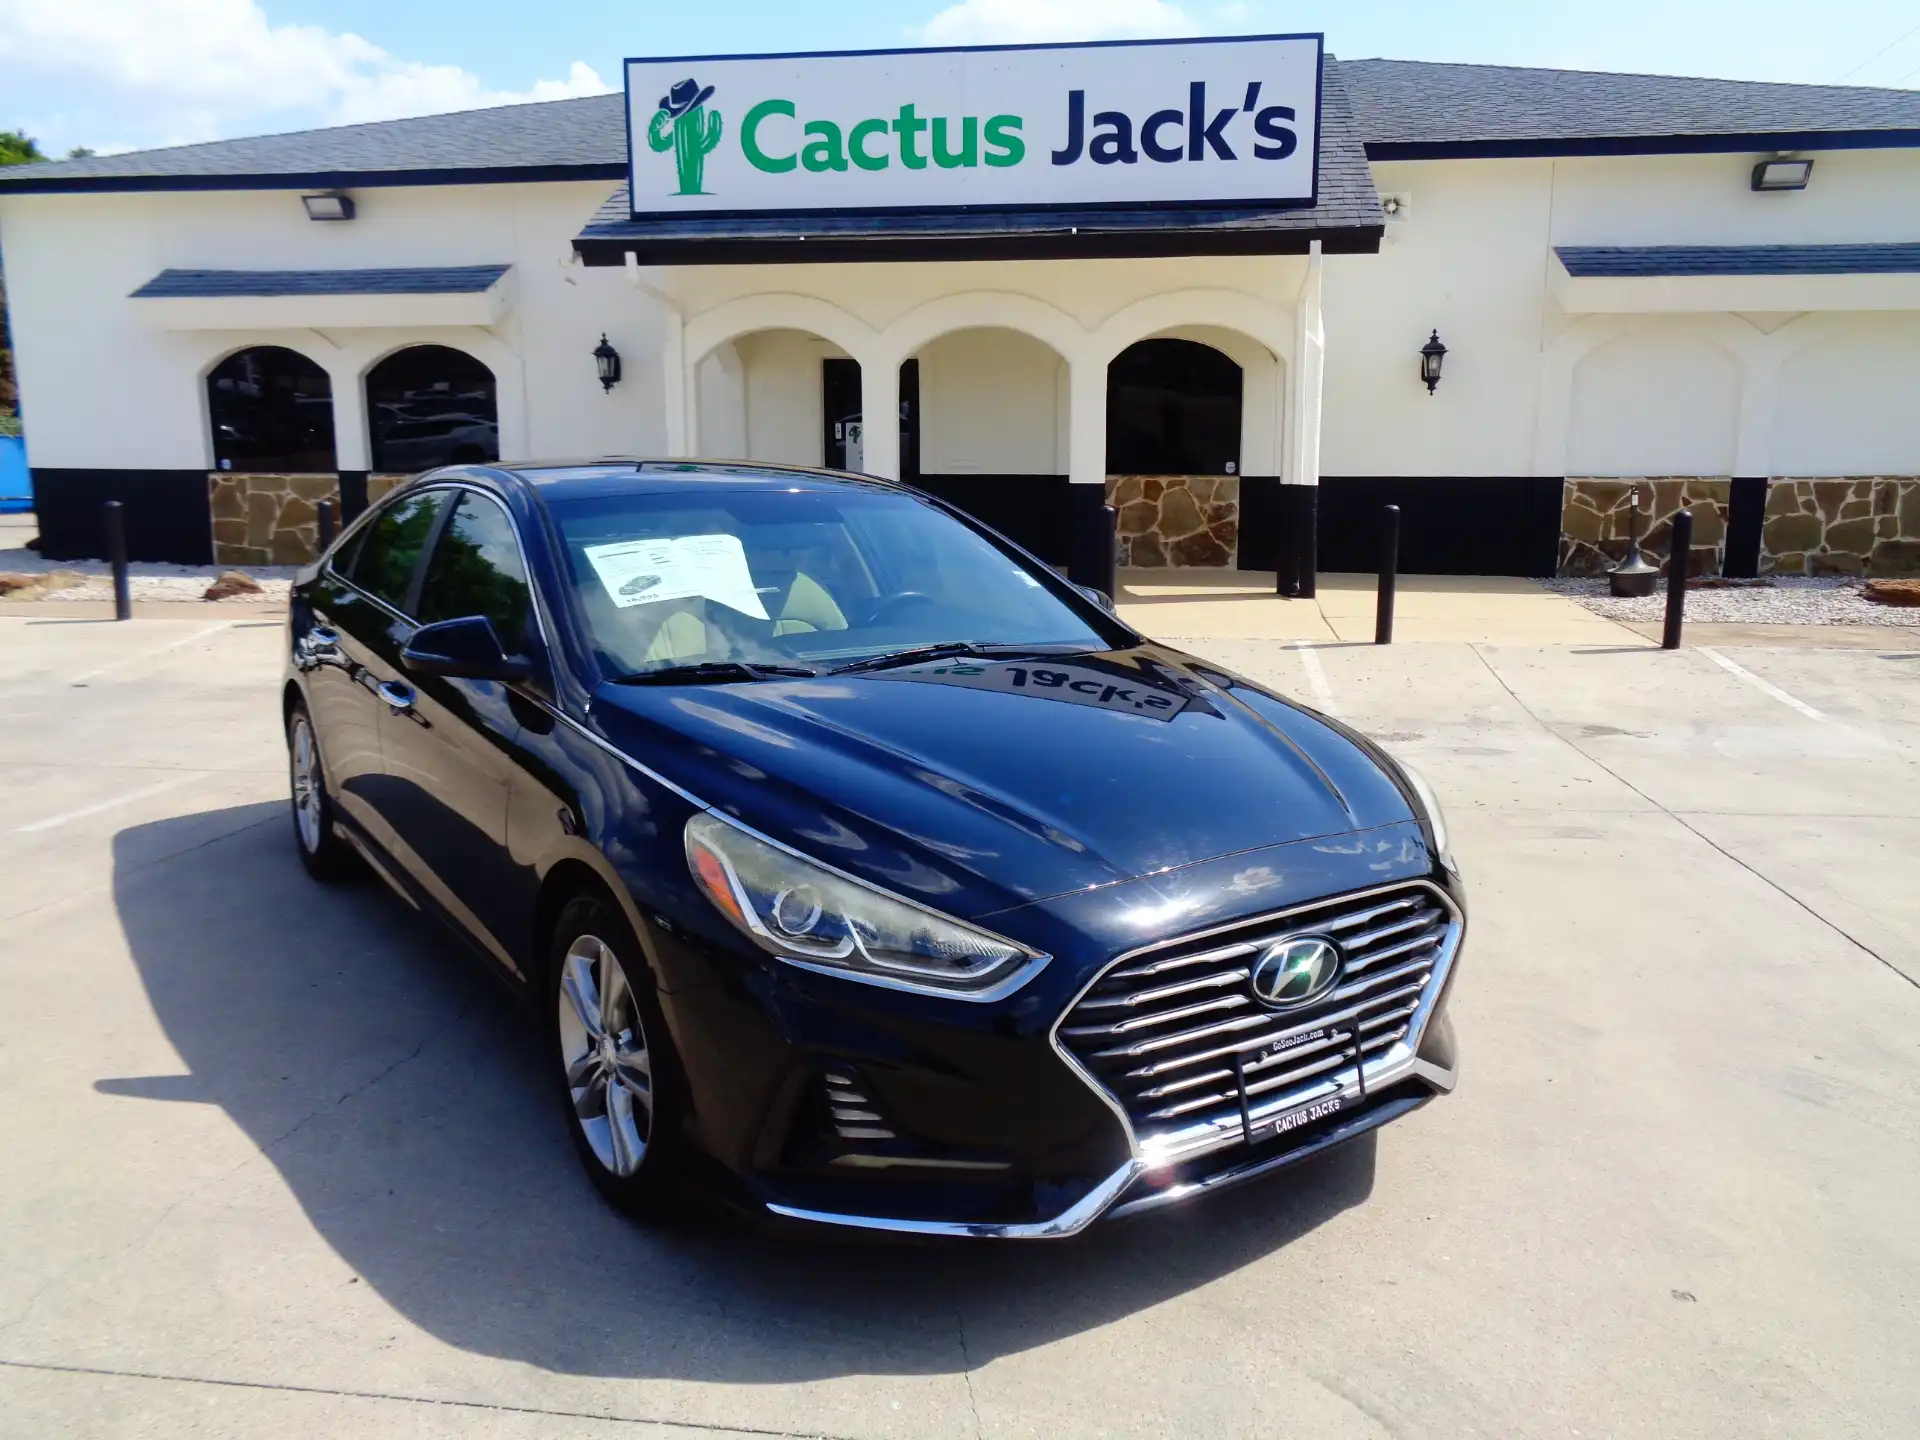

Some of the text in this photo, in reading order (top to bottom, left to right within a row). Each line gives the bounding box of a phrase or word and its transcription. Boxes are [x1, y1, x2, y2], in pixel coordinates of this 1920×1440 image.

[740, 81, 1297, 174] Cactus Jack's
[1275, 1110, 1308, 1133] CACTUS
